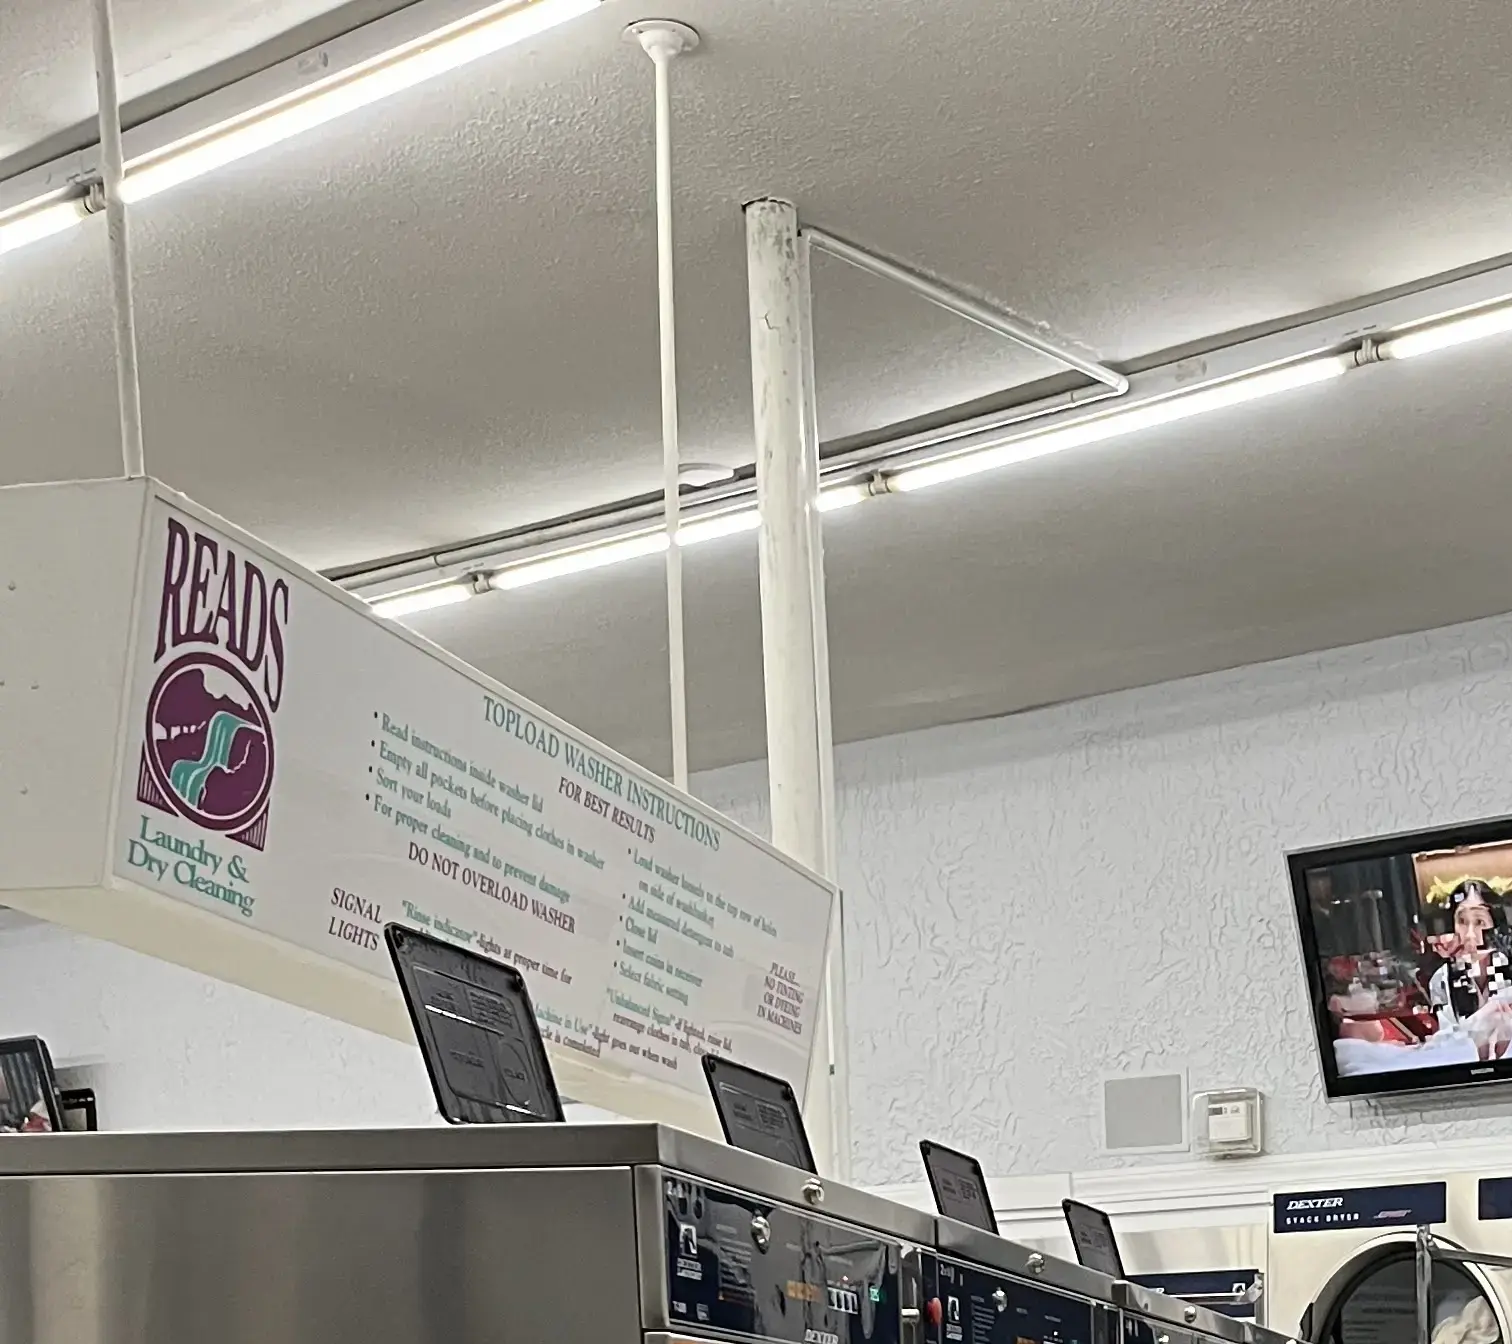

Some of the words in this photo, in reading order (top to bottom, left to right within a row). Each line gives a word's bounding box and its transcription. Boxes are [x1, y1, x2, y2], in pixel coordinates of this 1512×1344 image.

[154, 517, 289, 713] READS
[381, 712, 409, 742] Read
[411, 729, 467, 773] instructions
[376, 767, 398, 794] Sort
[402, 783, 424, 804] your
[426, 791, 452, 819] loads
[379, 740, 413, 775] Empty
[416, 761, 428, 780] all
[430, 774, 468, 802] pockets
[470, 787, 499, 817] before
[501, 806, 534, 837] placing
[535, 823, 565, 850] clothes
[566, 838, 575, 855] in
[483, 695, 560, 758] TOPLOAD
[564, 741, 623, 797] WASHER
[627, 778, 721, 852] INSTRUCTIONS
[558, 776, 581, 803] FOR
[584, 791, 611, 819] BEST
[611, 807, 656, 844] RESULTS
[139, 814, 223, 879] Laundry
[228, 855, 250, 883] &
[374, 793, 393, 814] For
[395, 808, 428, 835] proper
[431, 822, 471, 859] cleaning
[473, 847, 491, 864] and
[492, 855, 502, 869] to
[504, 862, 537, 887] prevent
[539, 873, 570, 904] damage
[128, 838, 169, 881] Dry
[173, 861, 255, 918] Cleaning
[330, 886, 382, 924] SIGNAL
[408, 841, 430, 866] DO
[432, 854, 460, 881] NOT
[462, 867, 529, 912] OVERLOAD
[531, 898, 576, 934] WASHER
[328, 916, 380, 951] LIGHTS
[503, 947, 513, 960] at
[513, 952, 540, 973] proper
[541, 963, 559, 981] time
[560, 967, 573, 985] for
[764, 975, 776, 991] NO
[757, 1004, 766, 1018] IN
[763, 991, 775, 1006] OR
[1286, 1197, 1344, 1210] DEXTER
[1286, 1214, 1319, 1225] STACK
